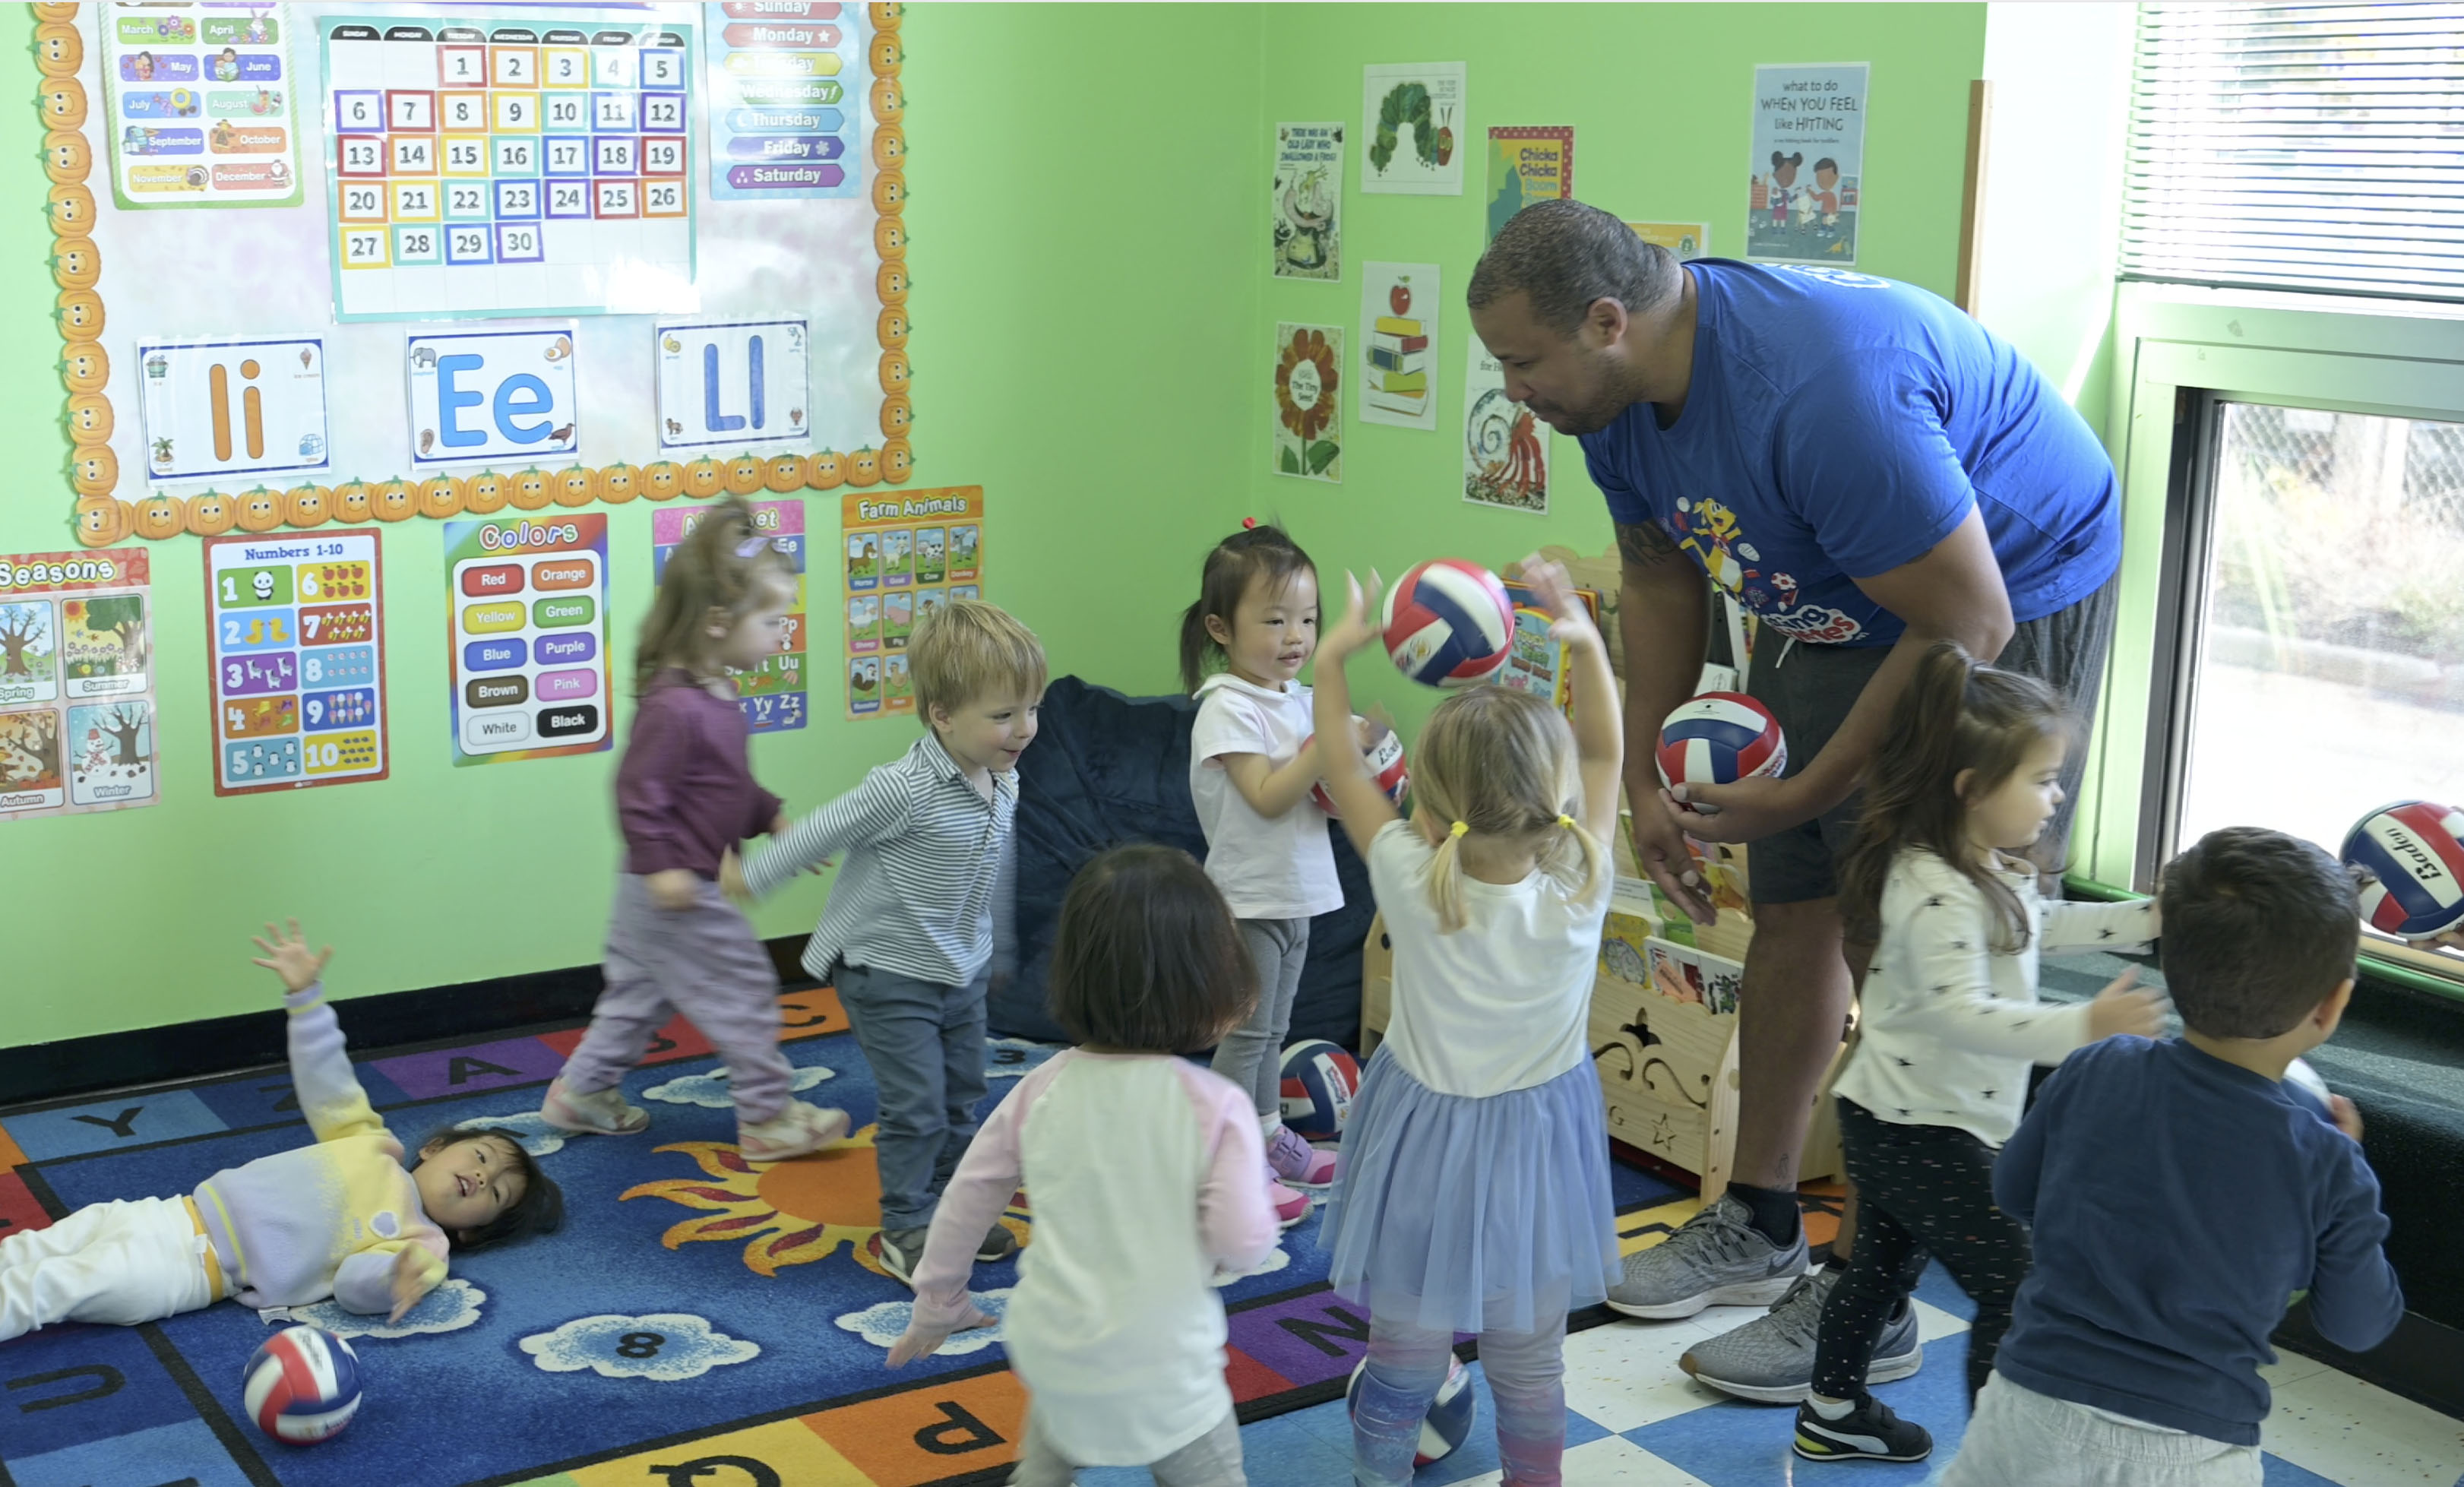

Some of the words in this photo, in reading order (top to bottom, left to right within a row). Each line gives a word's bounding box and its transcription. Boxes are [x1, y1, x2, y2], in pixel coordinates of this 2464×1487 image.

[754, 2, 811, 15] Sunday
[122, 24, 153, 34] March
[209, 24, 234, 35] April
[753, 27, 813, 44] Monday
[171, 62, 191, 74] May
[246, 62, 271, 71] June
[457, 58, 470, 75] 1
[508, 59, 522, 77] 2
[560, 59, 572, 77] 3
[608, 59, 619, 77] 4
[656, 61, 667, 78] 5
[1782, 81, 1808, 91] what
[1811, 81, 1821, 91] to
[1824, 79, 1838, 91] do
[129, 99, 150, 111] July
[212, 99, 248, 110] August
[1761, 97, 1796, 111] WHEN
[1801, 96, 1826, 111] YOU
[1830, 96, 1858, 111] FEEL
[353, 103, 366, 121] 6
[403, 103, 416, 120] 7
[456, 103, 469, 121] 8
[509, 103, 522, 122] 9
[553, 103, 577, 121] 10
[603, 104, 625, 122] 11
[650, 104, 675, 122] 12
[752, 112, 821, 128] Thursday
[1774, 118, 1792, 129] like
[1795, 117, 1843, 131] HITTING
[149, 136, 202, 147] September
[240, 135, 281, 145] October
[348, 147, 375, 165] 13
[400, 145, 425, 163] 14
[451, 147, 477, 164] 15
[502, 147, 527, 165] 16
[554, 147, 577, 165] 17
[603, 147, 628, 164] 18
[650, 147, 675, 165] 19
[764, 141, 811, 157] Friday
[1520, 147, 1558, 162] Chicka
[216, 172, 265, 182] December
[753, 169, 821, 183] Saturday
[1520, 163, 1558, 176] Chicka
[133, 173, 182, 183] November
[349, 191, 375, 210] 20
[402, 191, 429, 210] 21
[453, 191, 479, 209] 22
[505, 190, 530, 208] 23
[555, 189, 580, 207] 24
[603, 189, 628, 207] 25
[650, 188, 675, 206] 26
[351, 237, 378, 257] 27
[404, 235, 430, 254] 28
[456, 235, 482, 254] 29
[508, 233, 532, 252] 30
[1292, 381, 1304, 391] The
[437, 353, 554, 448] Ee
[859, 500, 899, 520] Farm
[903, 495, 967, 517] Animals
[479, 522, 579, 550] Colors
[245, 546, 309, 561] Numbers
[317, 543, 343, 555] 1-10
[0, 560, 115, 587] Seasons
[481, 573, 506, 586] Red
[541, 569, 586, 582] Orange
[222, 577, 238, 601] 1
[302, 572, 318, 596] 6
[476, 611, 516, 624] Yellow
[546, 605, 583, 618] Green
[224, 621, 241, 645] 2
[303, 615, 321, 639] 7
[482, 648, 511, 661] Blue
[546, 641, 586, 656] Purple
[305, 658, 323, 682] 8
[778, 655, 799, 670] Uu
[226, 663, 243, 688] 3
[82, 679, 129, 692] Summer
[479, 685, 518, 698] Brown
[554, 679, 580, 690] Pink
[0, 687, 35, 701] Spring
[753, 697, 773, 714] Yy
[779, 694, 800, 710] Zz
[228, 707, 245, 731] 4
[306, 700, 324, 724] 9
[482, 722, 517, 735] White
[551, 714, 586, 728] Black
[305, 742, 340, 768] 10
[232, 751, 249, 775] 5
[93, 785, 131, 798] Winter
[0, 794, 45, 808] Autumn
[2384, 827, 2443, 881] Baden
[992, 1048, 1027, 1065] 3
[449, 1055, 522, 1086] A
[71, 1106, 144, 1137] Y
[1275, 1305, 1371, 1358] N
[615, 1332, 666, 1359] 8
[6, 1364, 127, 1413] U
[914, 1400, 1007, 1455] P
